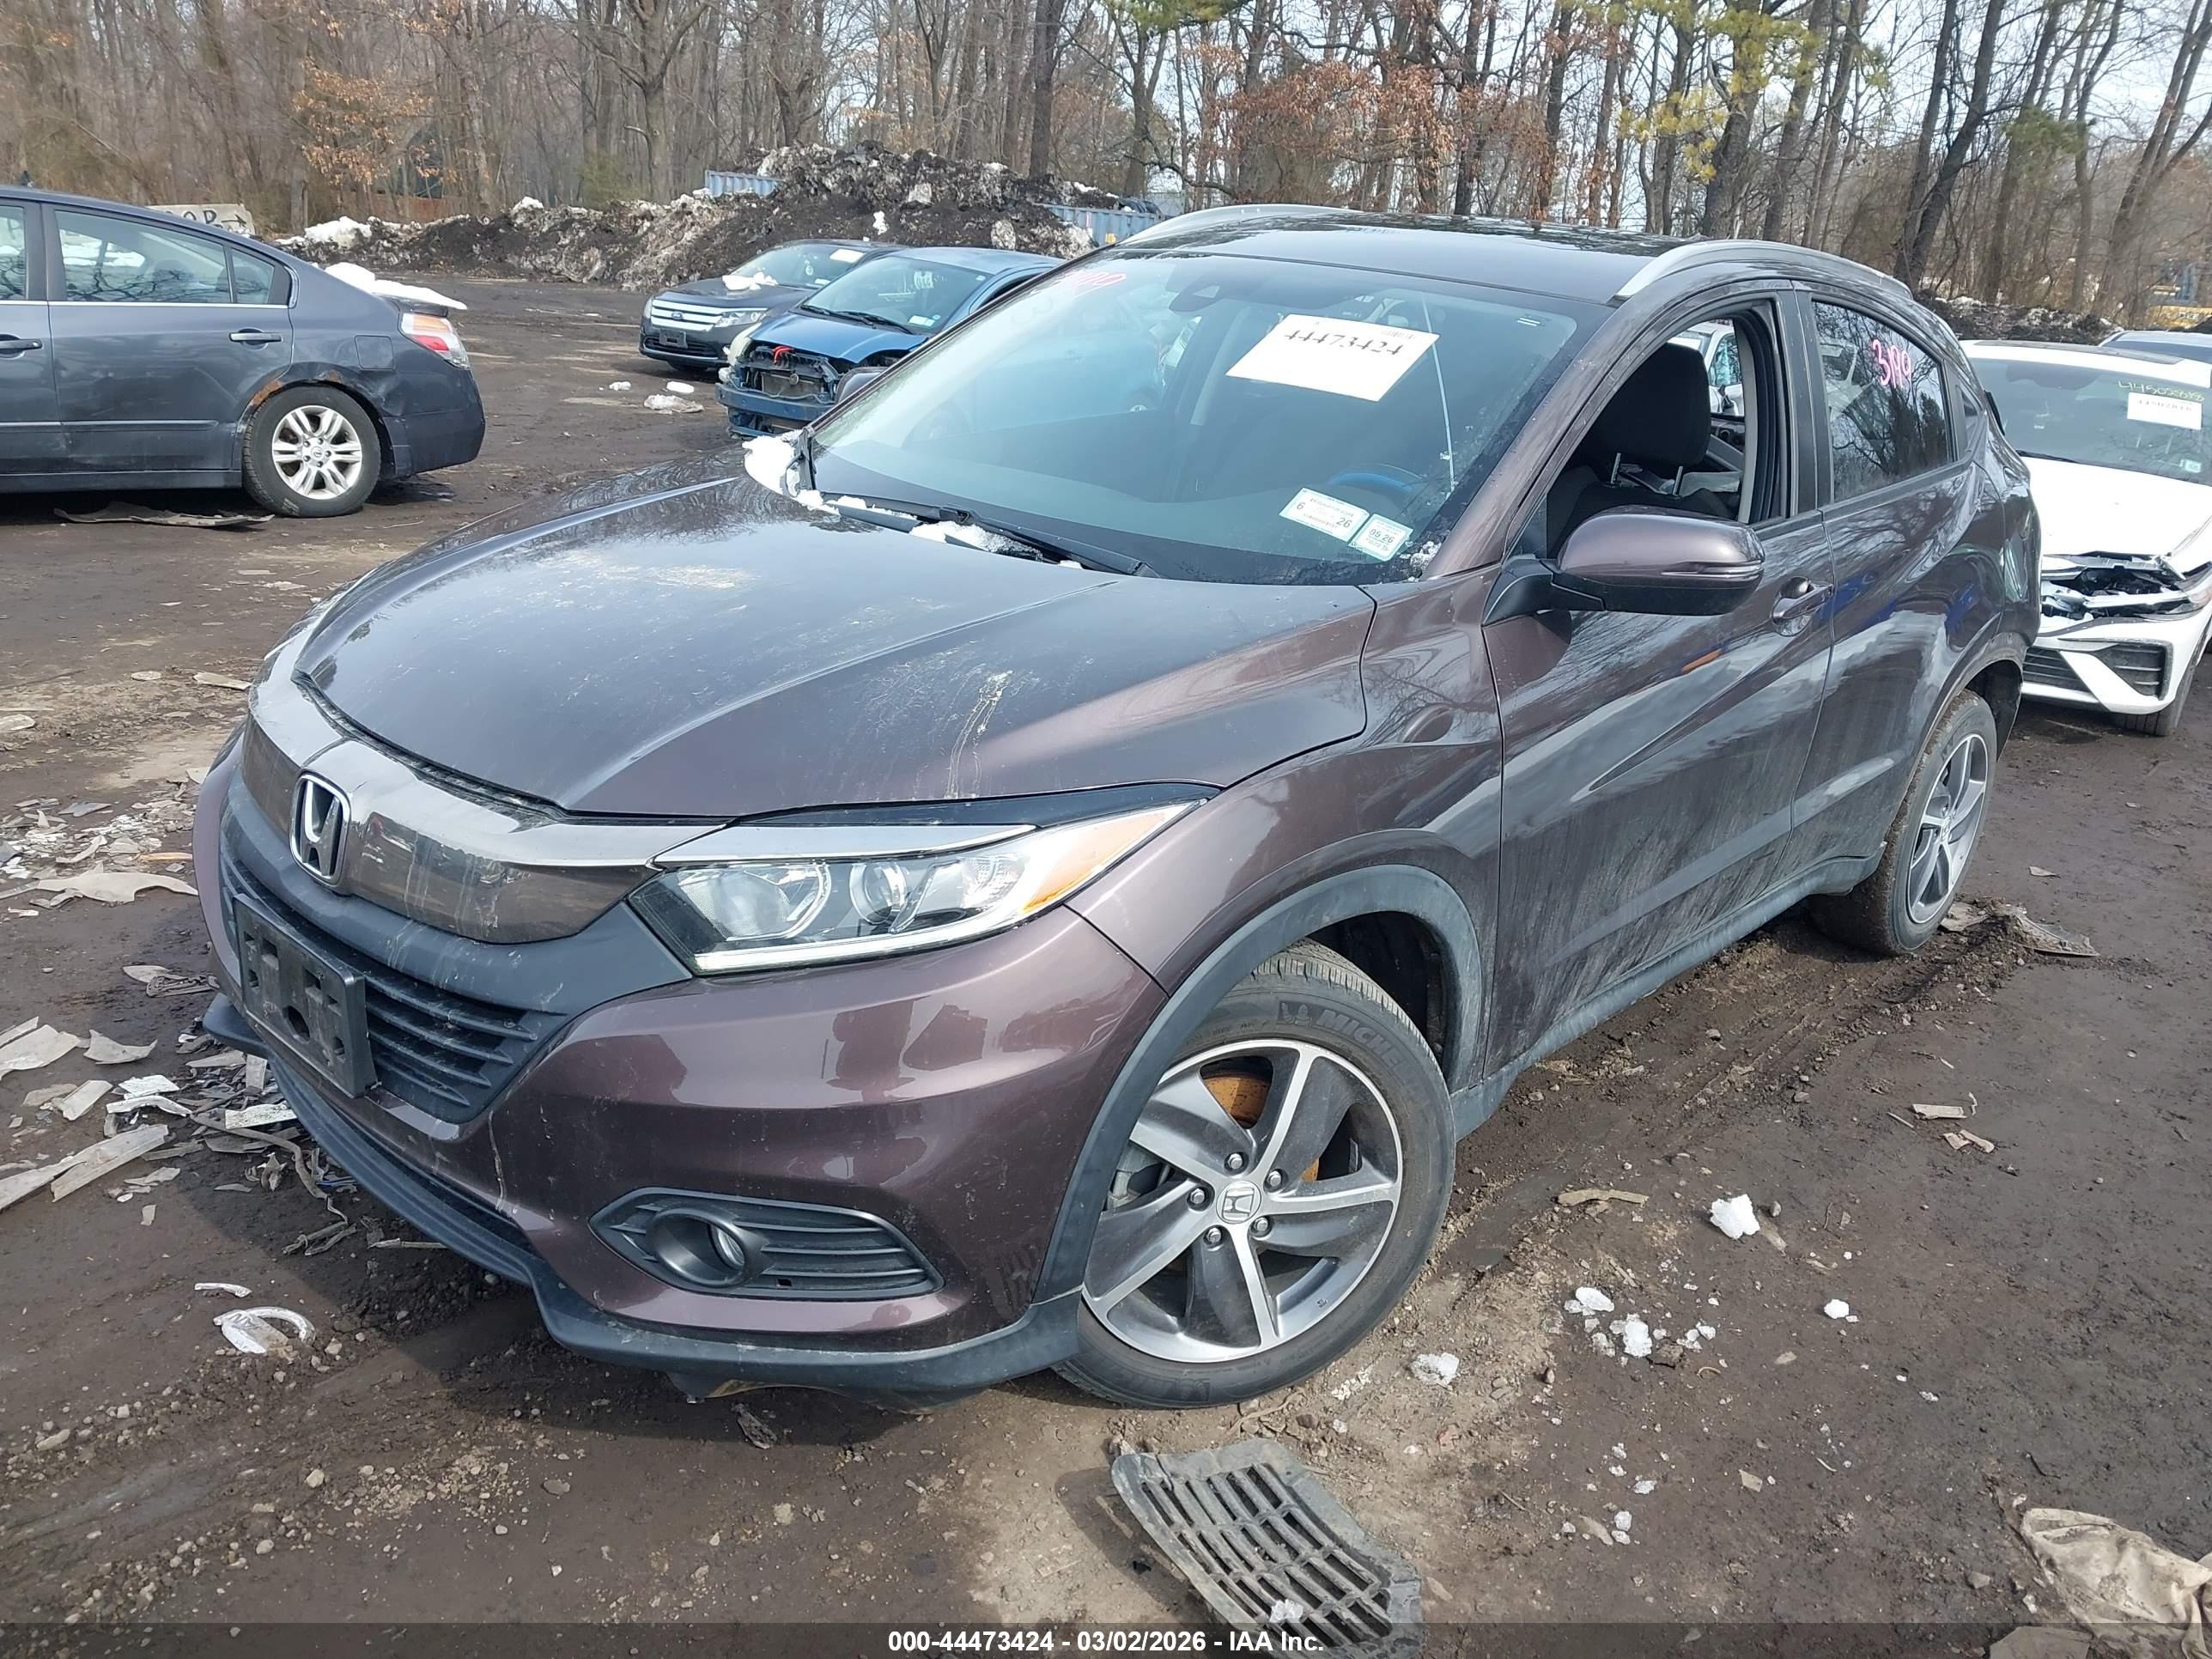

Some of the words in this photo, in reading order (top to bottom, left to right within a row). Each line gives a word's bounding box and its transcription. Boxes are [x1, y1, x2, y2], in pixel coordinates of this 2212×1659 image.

[1285, 329, 1404, 356] 44473424
[1297, 501, 1306, 511] 6
[1336, 517, 1352, 529] 26
